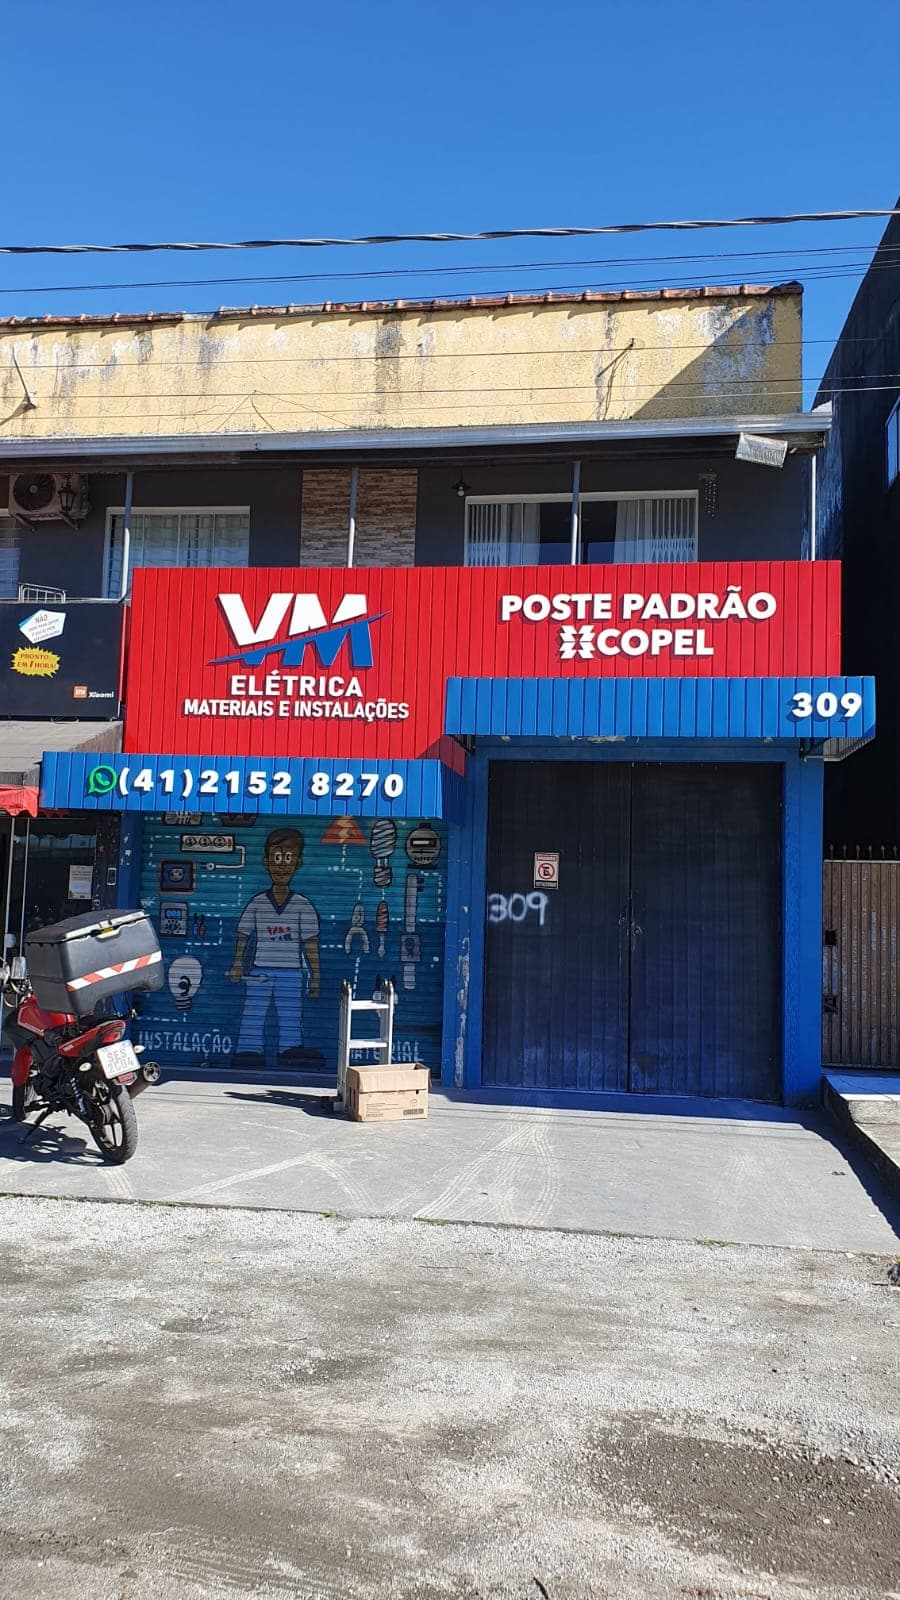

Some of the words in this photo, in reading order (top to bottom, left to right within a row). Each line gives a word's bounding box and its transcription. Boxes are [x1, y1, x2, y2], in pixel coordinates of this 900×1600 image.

[501, 592, 612, 621] POSTE
[623, 585, 777, 620] PADRÃO
[214, 592, 376, 668] VM
[597, 628, 714, 656] COPEL
[230, 670, 364, 697] ELÉTRICA
[184, 698, 274, 718] MATERIAIS
[279, 700, 290, 717] E
[294, 697, 410, 722] INSTALAÇÕES
[791, 691, 862, 719] 309
[311, 771, 405, 799] 8270
[487, 890, 549, 926] 309
[106, 1047, 128, 1063] SES
[138, 1028, 233, 1060] INSTALAÇÃO
